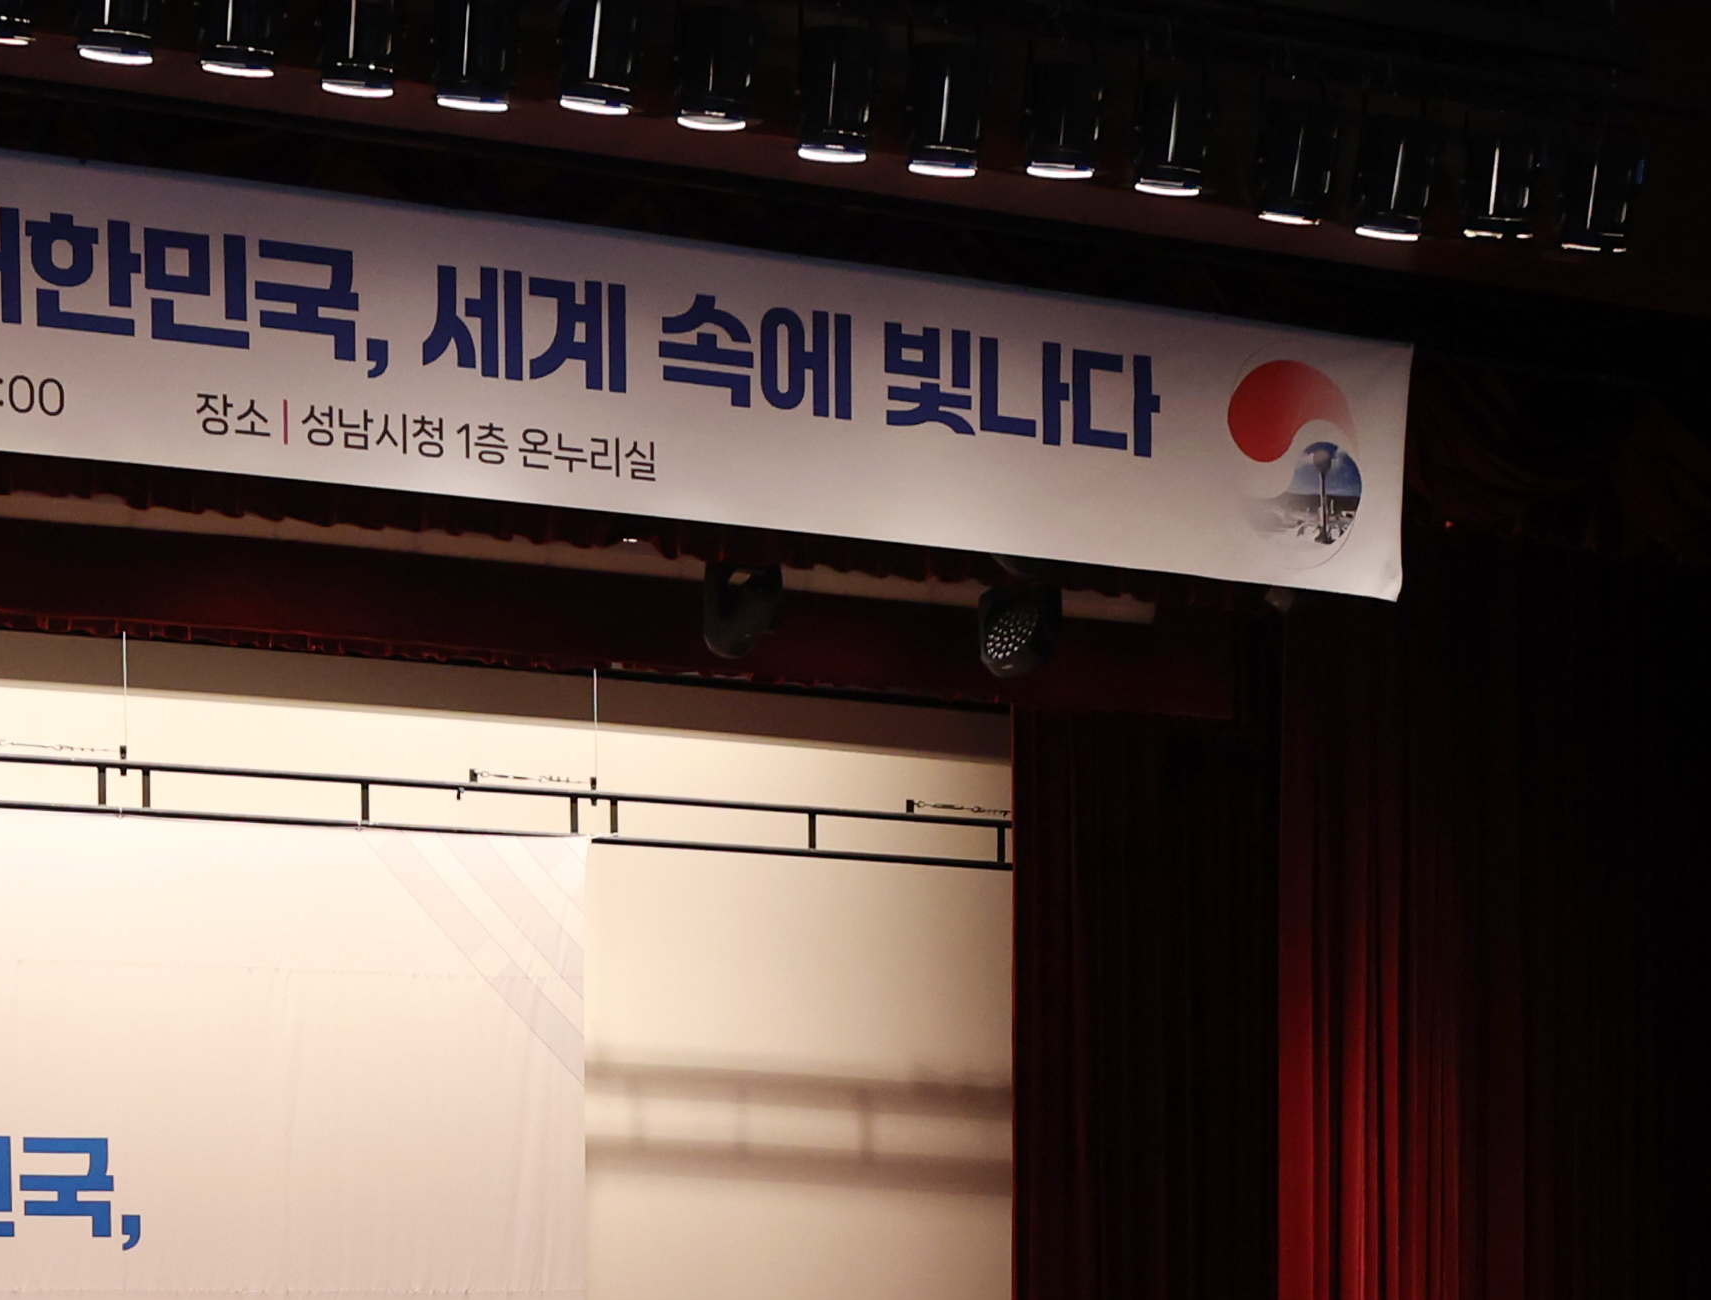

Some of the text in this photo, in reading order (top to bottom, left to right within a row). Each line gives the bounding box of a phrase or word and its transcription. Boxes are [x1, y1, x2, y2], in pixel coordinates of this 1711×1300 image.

[422, 265, 626, 394] 세계
[659, 294, 855, 421] 속에
[883, 320, 1160, 458] 빛나다
[195, 392, 657, 482] 장소 성남시청 1층 온누리실
